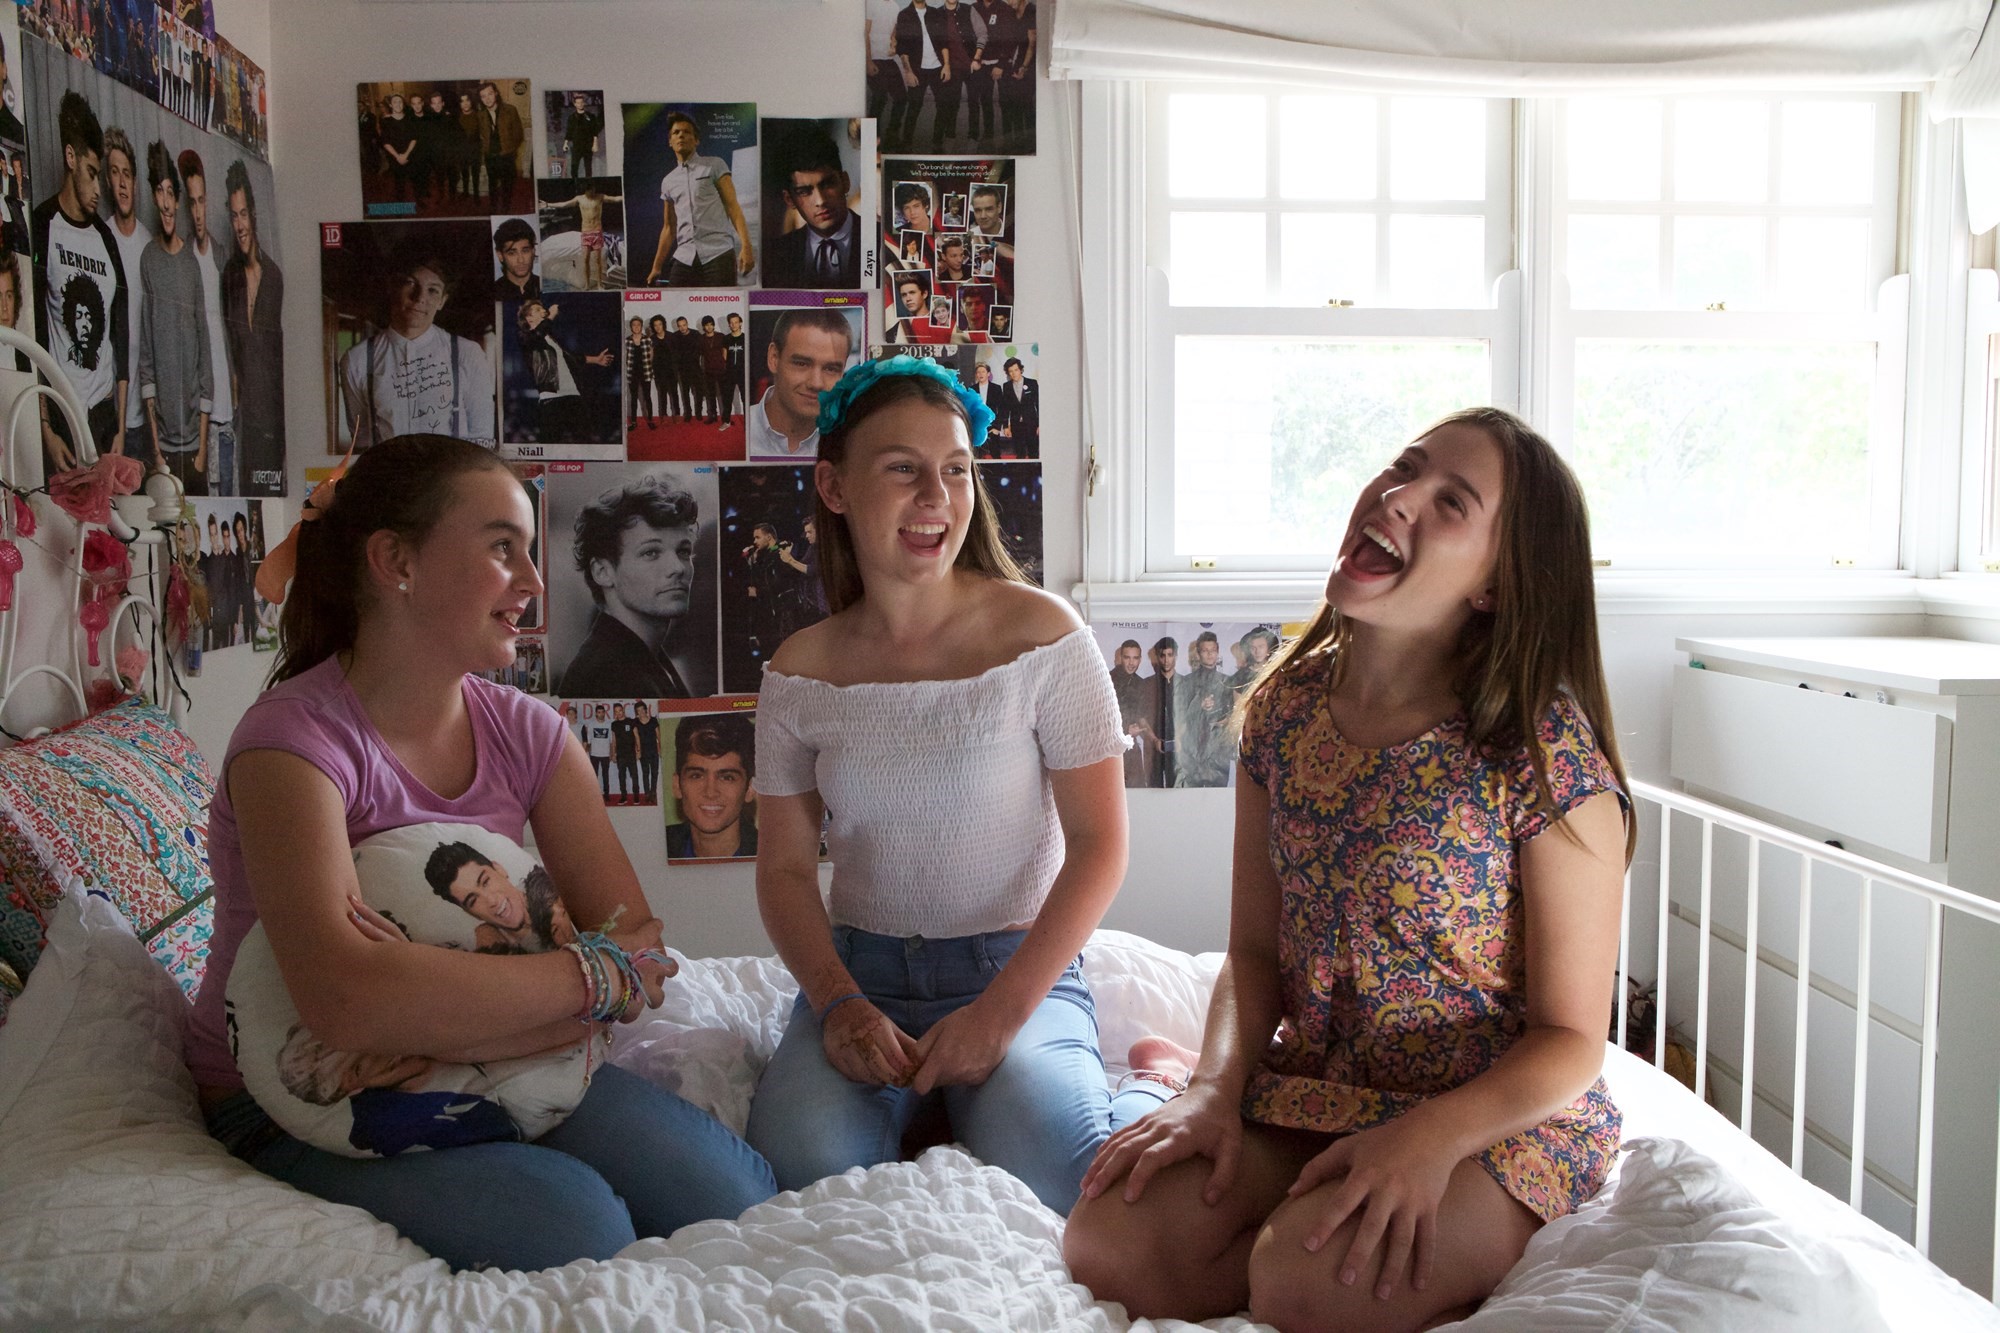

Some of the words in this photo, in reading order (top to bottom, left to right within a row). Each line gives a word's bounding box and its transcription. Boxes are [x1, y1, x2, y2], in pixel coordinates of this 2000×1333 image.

[325, 226, 340, 244] 1D
[59, 249, 107, 277] HENDRIX
[864, 250, 876, 277] Zayn
[900, 345, 934, 359] 2013
[518, 447, 544, 456] Niall
